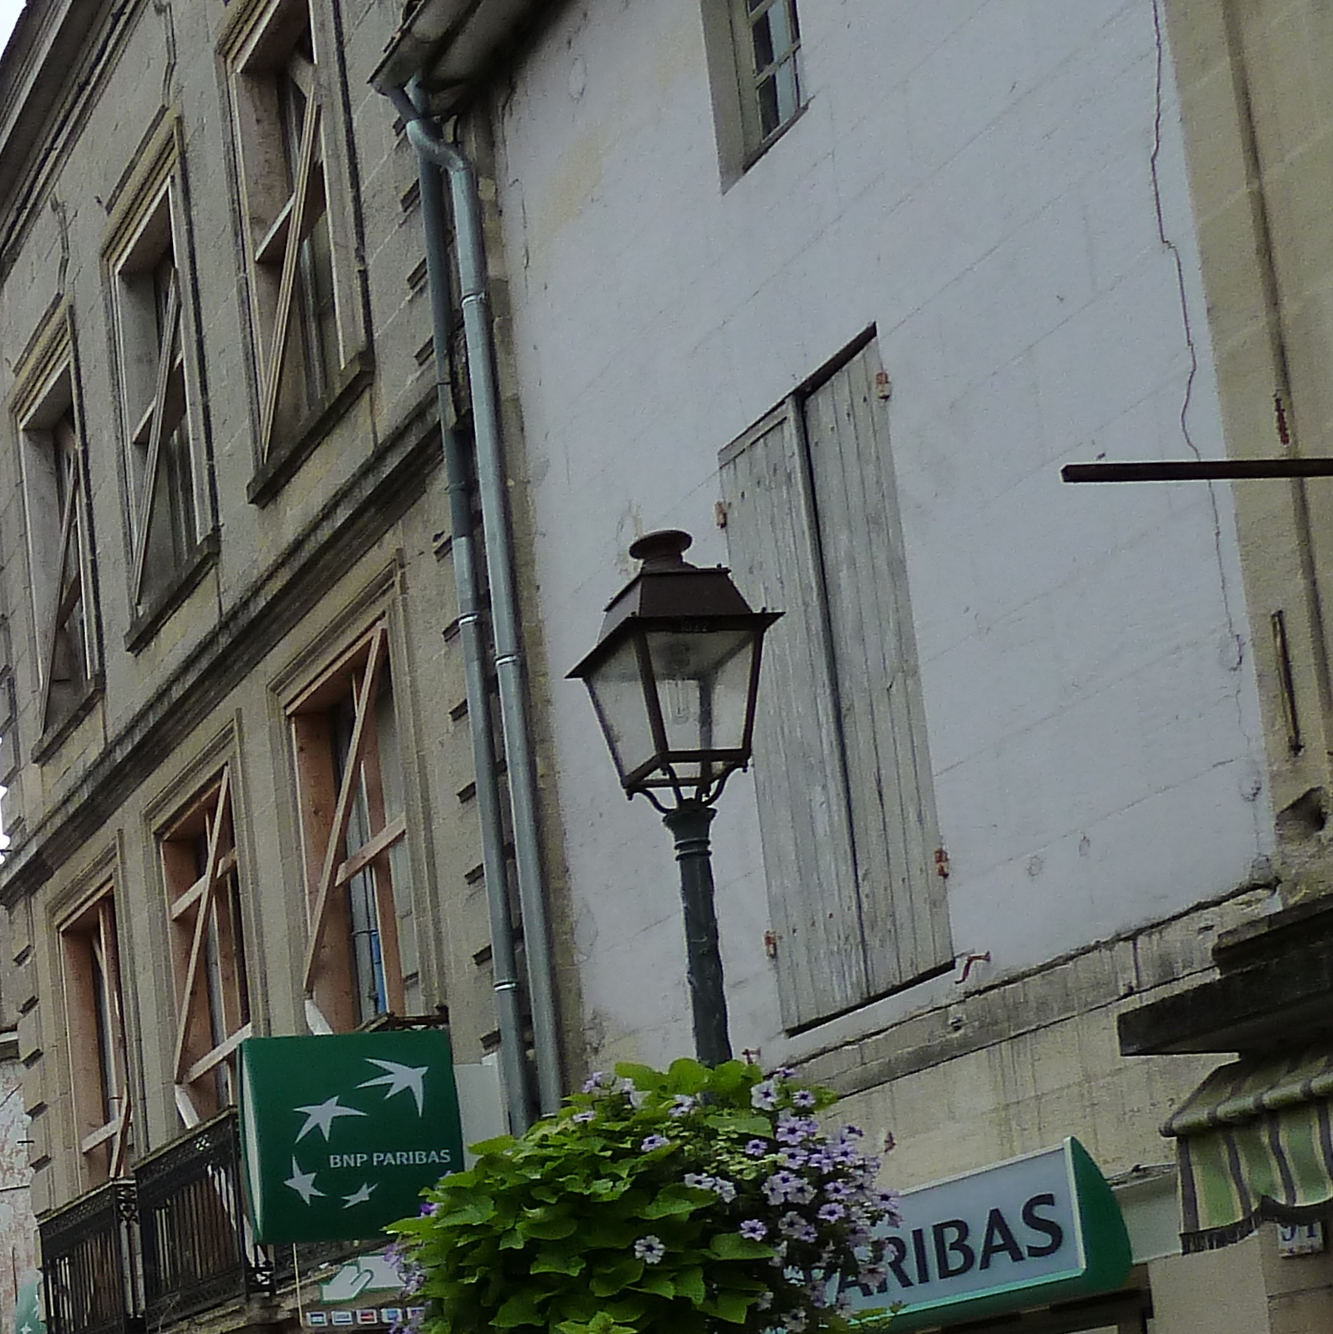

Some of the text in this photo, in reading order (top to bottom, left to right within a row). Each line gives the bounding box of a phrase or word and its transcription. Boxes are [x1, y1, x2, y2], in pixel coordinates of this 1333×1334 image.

[329, 1149, 451, 1168] BNP PARIBAS
[832, 1193, 1064, 1299] ARIBAS
